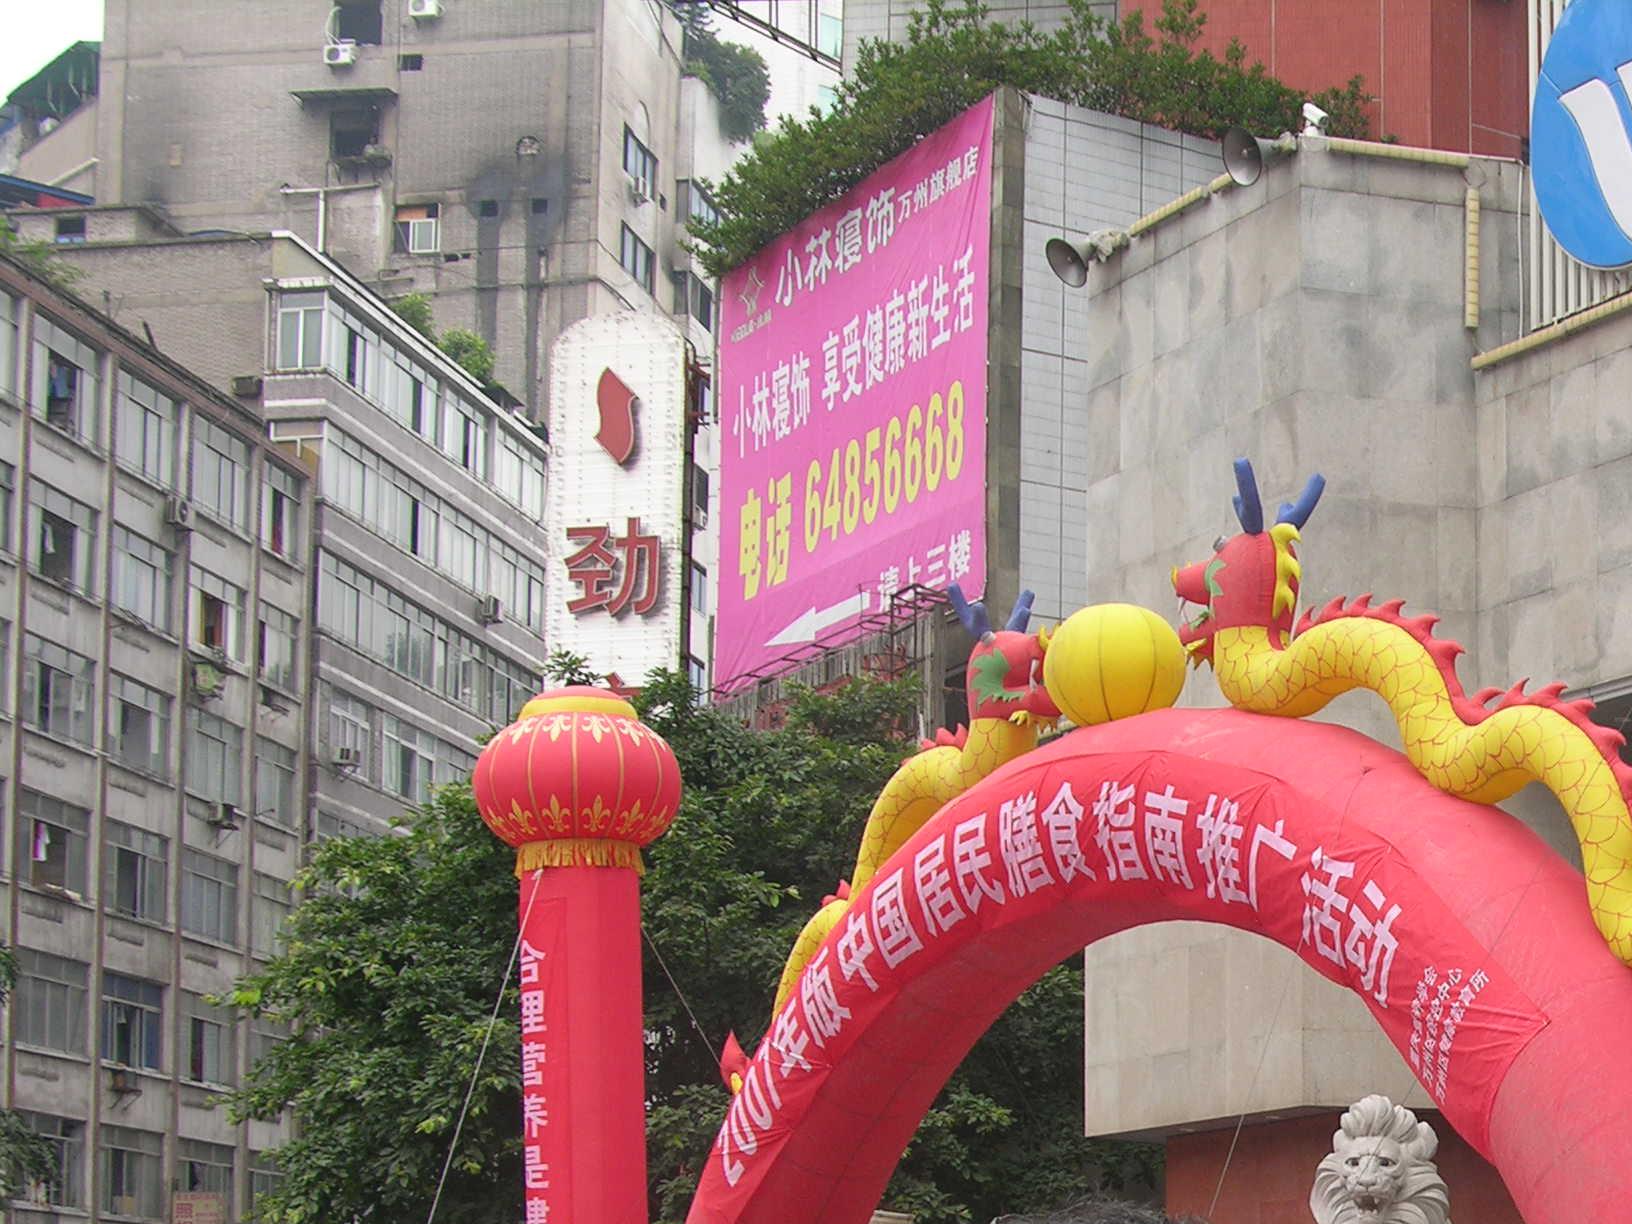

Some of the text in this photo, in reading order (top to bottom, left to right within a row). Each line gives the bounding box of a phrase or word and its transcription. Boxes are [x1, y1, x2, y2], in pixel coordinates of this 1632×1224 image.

[773, 186, 896, 306] 小林寝饰
[732, 249, 975, 458] 小林寝饰 享受健康新生活
[564, 516, 662, 619] 劲
[739, 380, 964, 601] 电话 64856668
